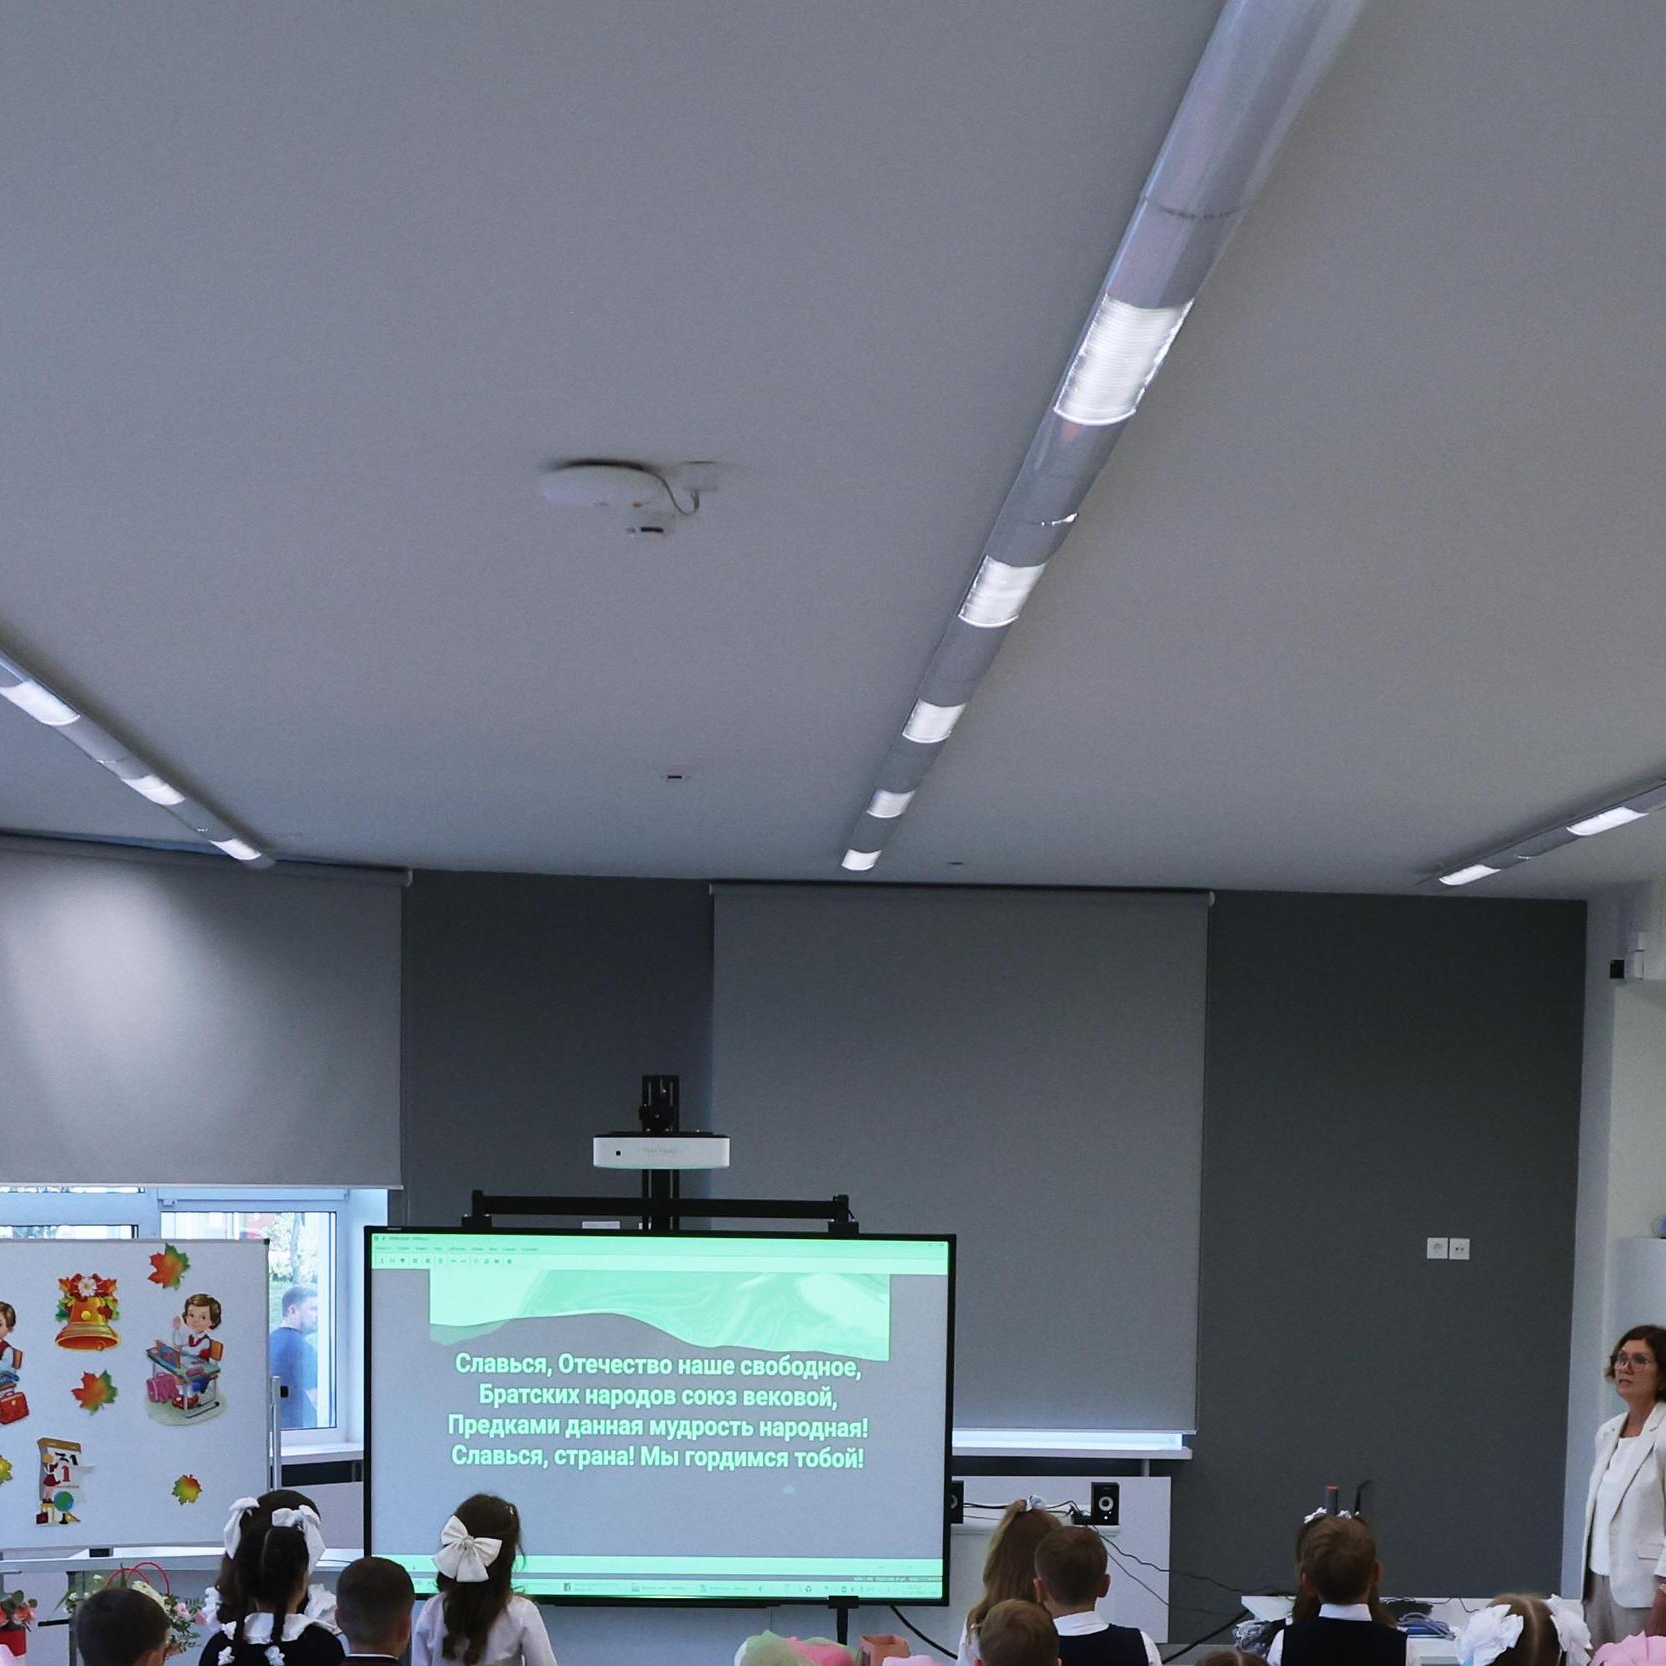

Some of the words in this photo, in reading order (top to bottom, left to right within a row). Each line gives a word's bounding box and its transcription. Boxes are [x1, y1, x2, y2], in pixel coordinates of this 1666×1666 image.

[455, 1352, 553, 1378] Славься,
[558, 1352, 673, 1375] Отечество
[678, 1358, 736, 1376] наше
[740, 1354, 862, 1381] свободное,
[479, 1383, 580, 1409] Братских
[585, 1388, 677, 1410] народов
[681, 1389, 738, 1406] союз
[743, 1385, 838, 1411] вековой,
[448, 1413, 560, 1440] Предками
[564, 1418, 644, 1439] данная
[649, 1419, 755, 1441] мудрость
[759, 1417, 868, 1442] народная!
[451, 1444, 549, 1469] Славься,
[554, 1445, 635, 1471] страна!
[640, 1445, 679, 1467] Мы
[684, 1450, 789, 1472] гордимся
[793, 1446, 864, 1469] тобой!
